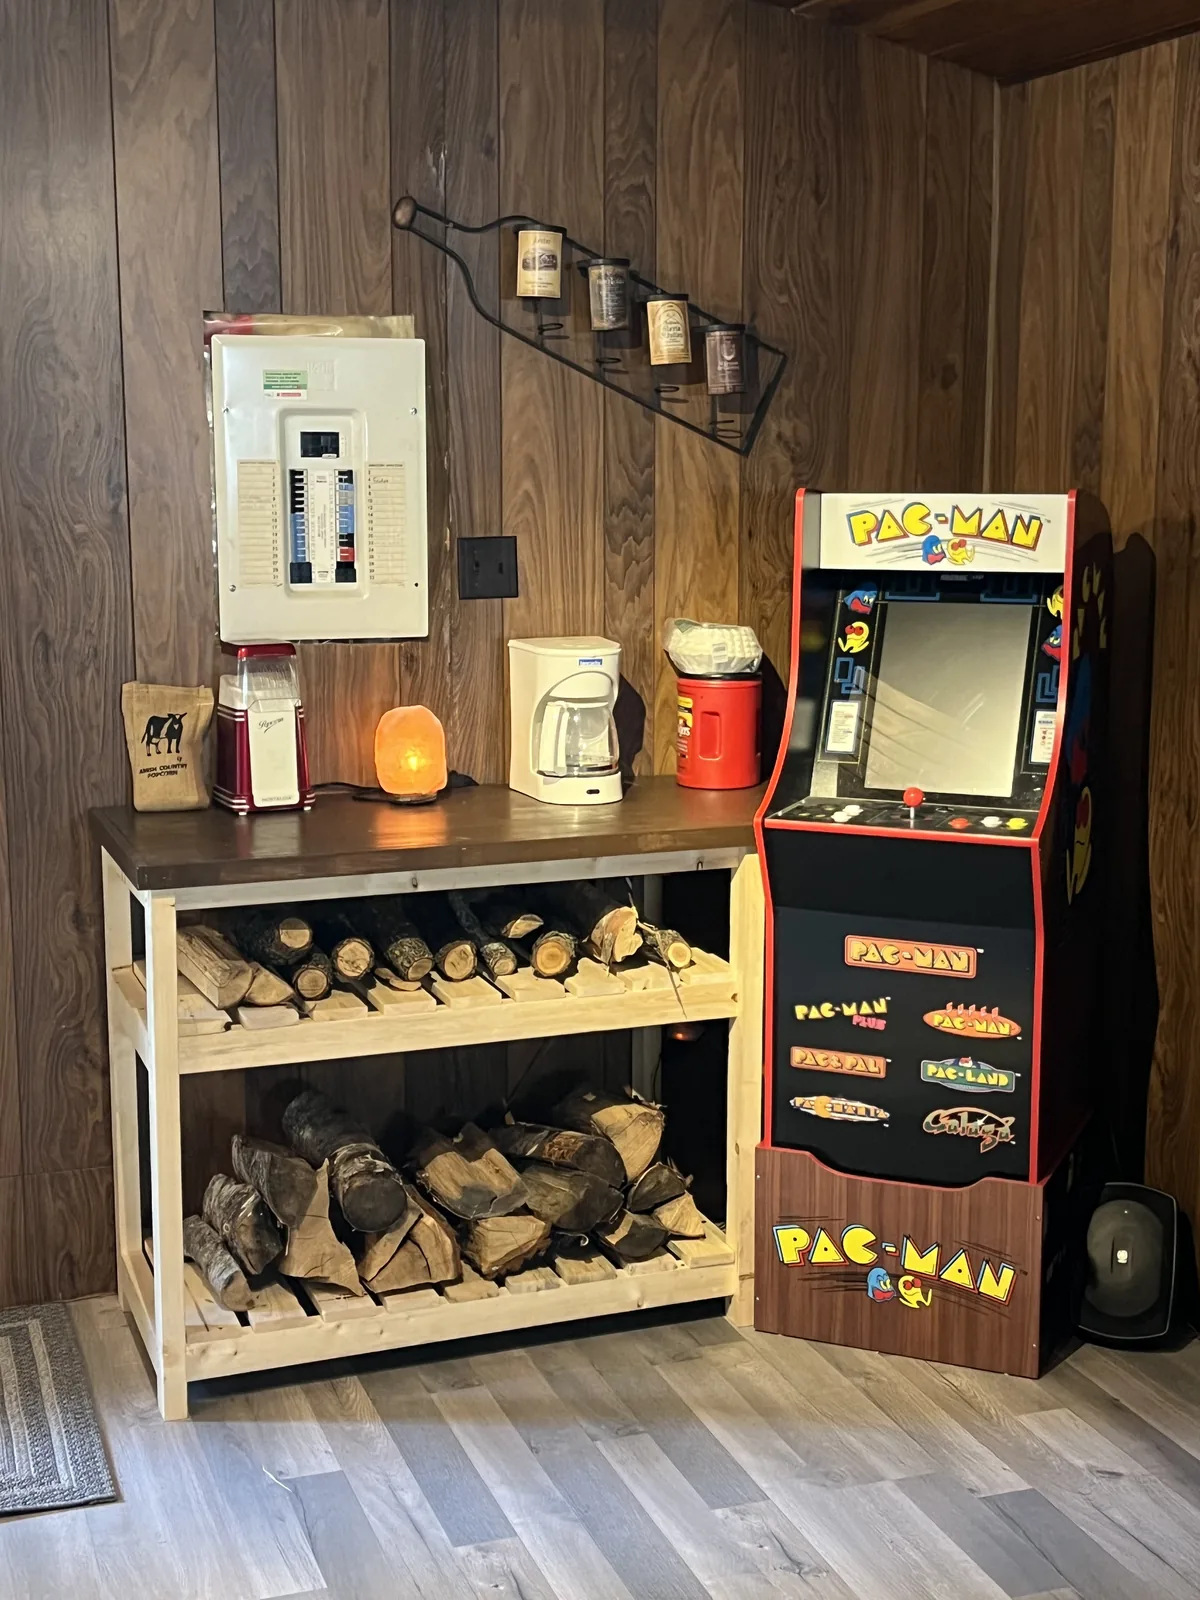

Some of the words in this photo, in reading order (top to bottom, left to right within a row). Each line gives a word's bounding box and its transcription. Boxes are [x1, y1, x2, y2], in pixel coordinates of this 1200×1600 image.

[847, 502, 1043, 551] PAC-MAN
[850, 940, 970, 973] PAC-MAN
[794, 998, 888, 1020] PAC-MAN
[852, 1014, 887, 1031] PLUS
[932, 1013, 1012, 1036] PAC-MAN
[926, 1064, 1009, 1087] PAC-LAND
[772, 1223, 1018, 1306] PAC-MAN
